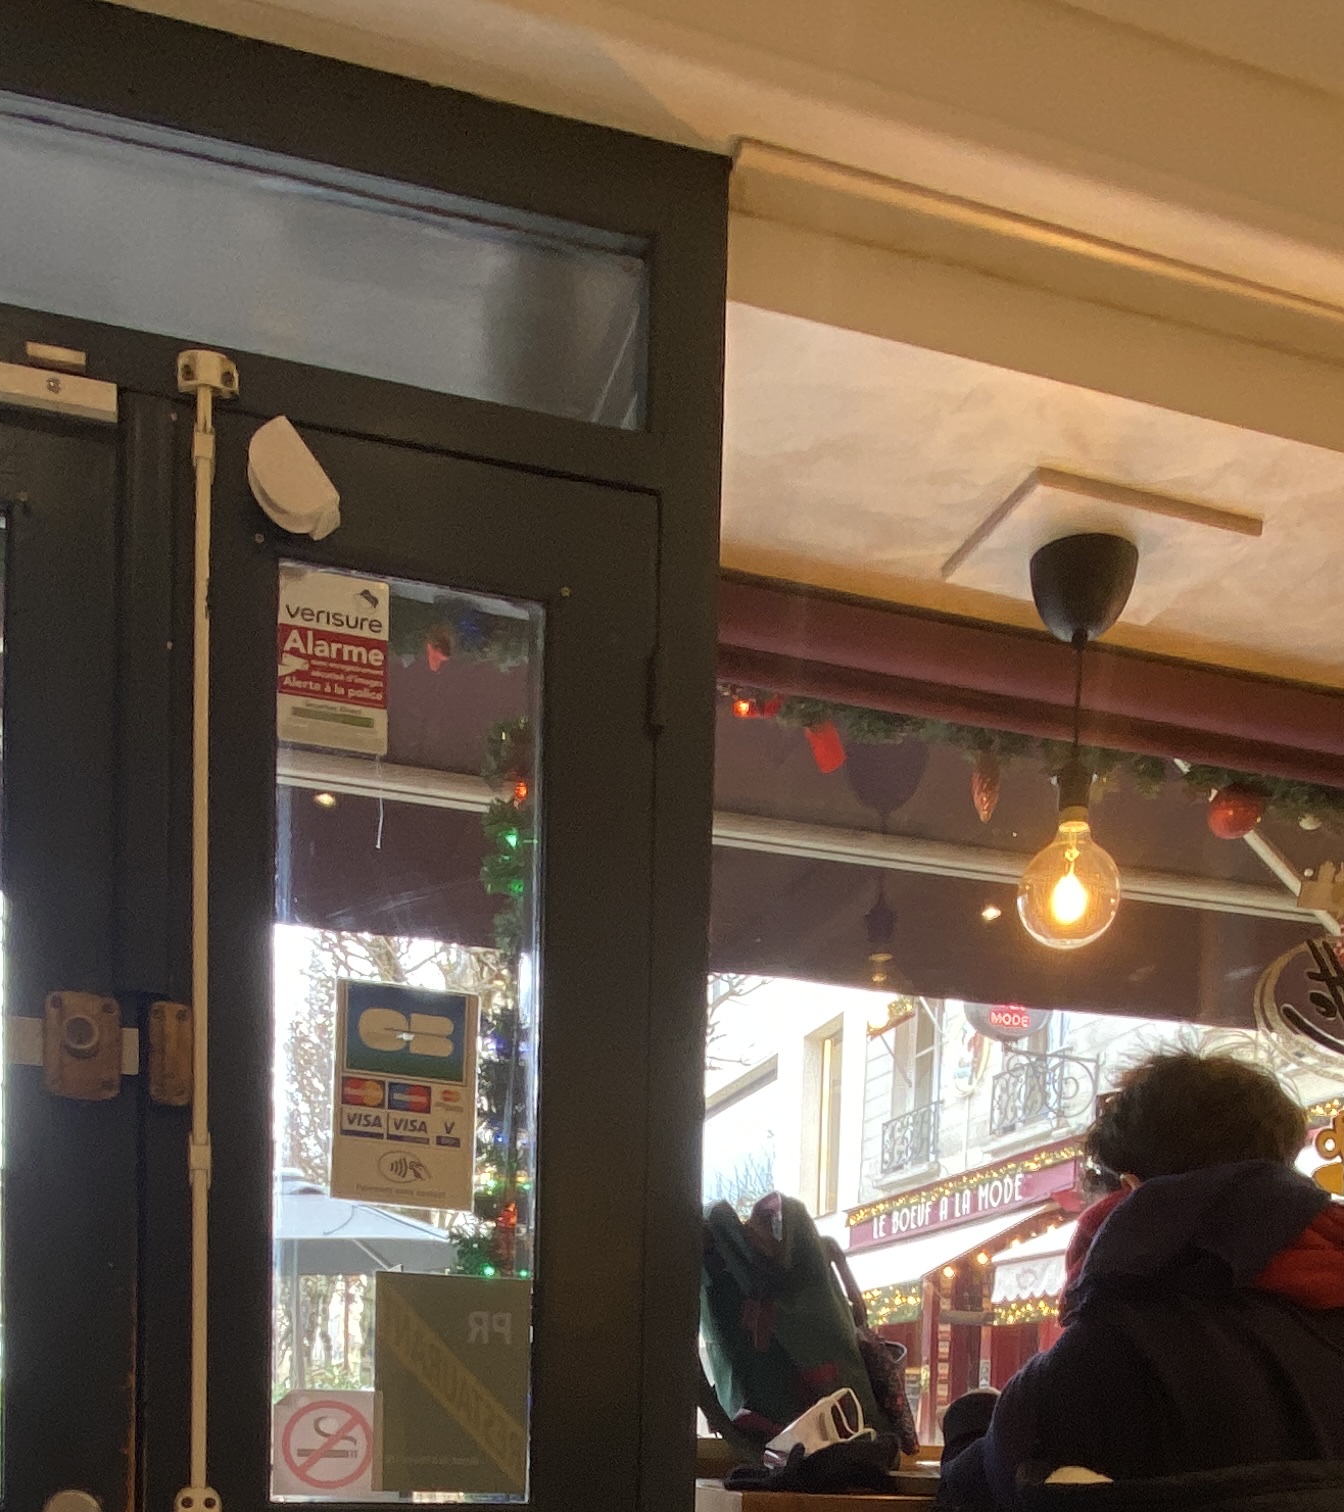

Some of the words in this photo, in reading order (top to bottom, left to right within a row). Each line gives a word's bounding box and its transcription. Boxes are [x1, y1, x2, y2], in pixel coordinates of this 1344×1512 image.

[286, 604, 383, 633] verisure
[283, 629, 385, 666] Alarme
[283, 675, 322, 692] Alerte
[324, 682, 332, 693] à
[334, 683, 345, 695] la
[347, 687, 384, 701] police
[990, 1011, 1030, 1029] MODE
[346, 1112, 382, 1128] VISA
[393, 1118, 428, 1134] VISA
[871, 1214, 887, 1239] LE
[891, 1200, 932, 1234] BOEUF
[954, 1192, 971, 1219] LA
[977, 1172, 1024, 1211] MODE
